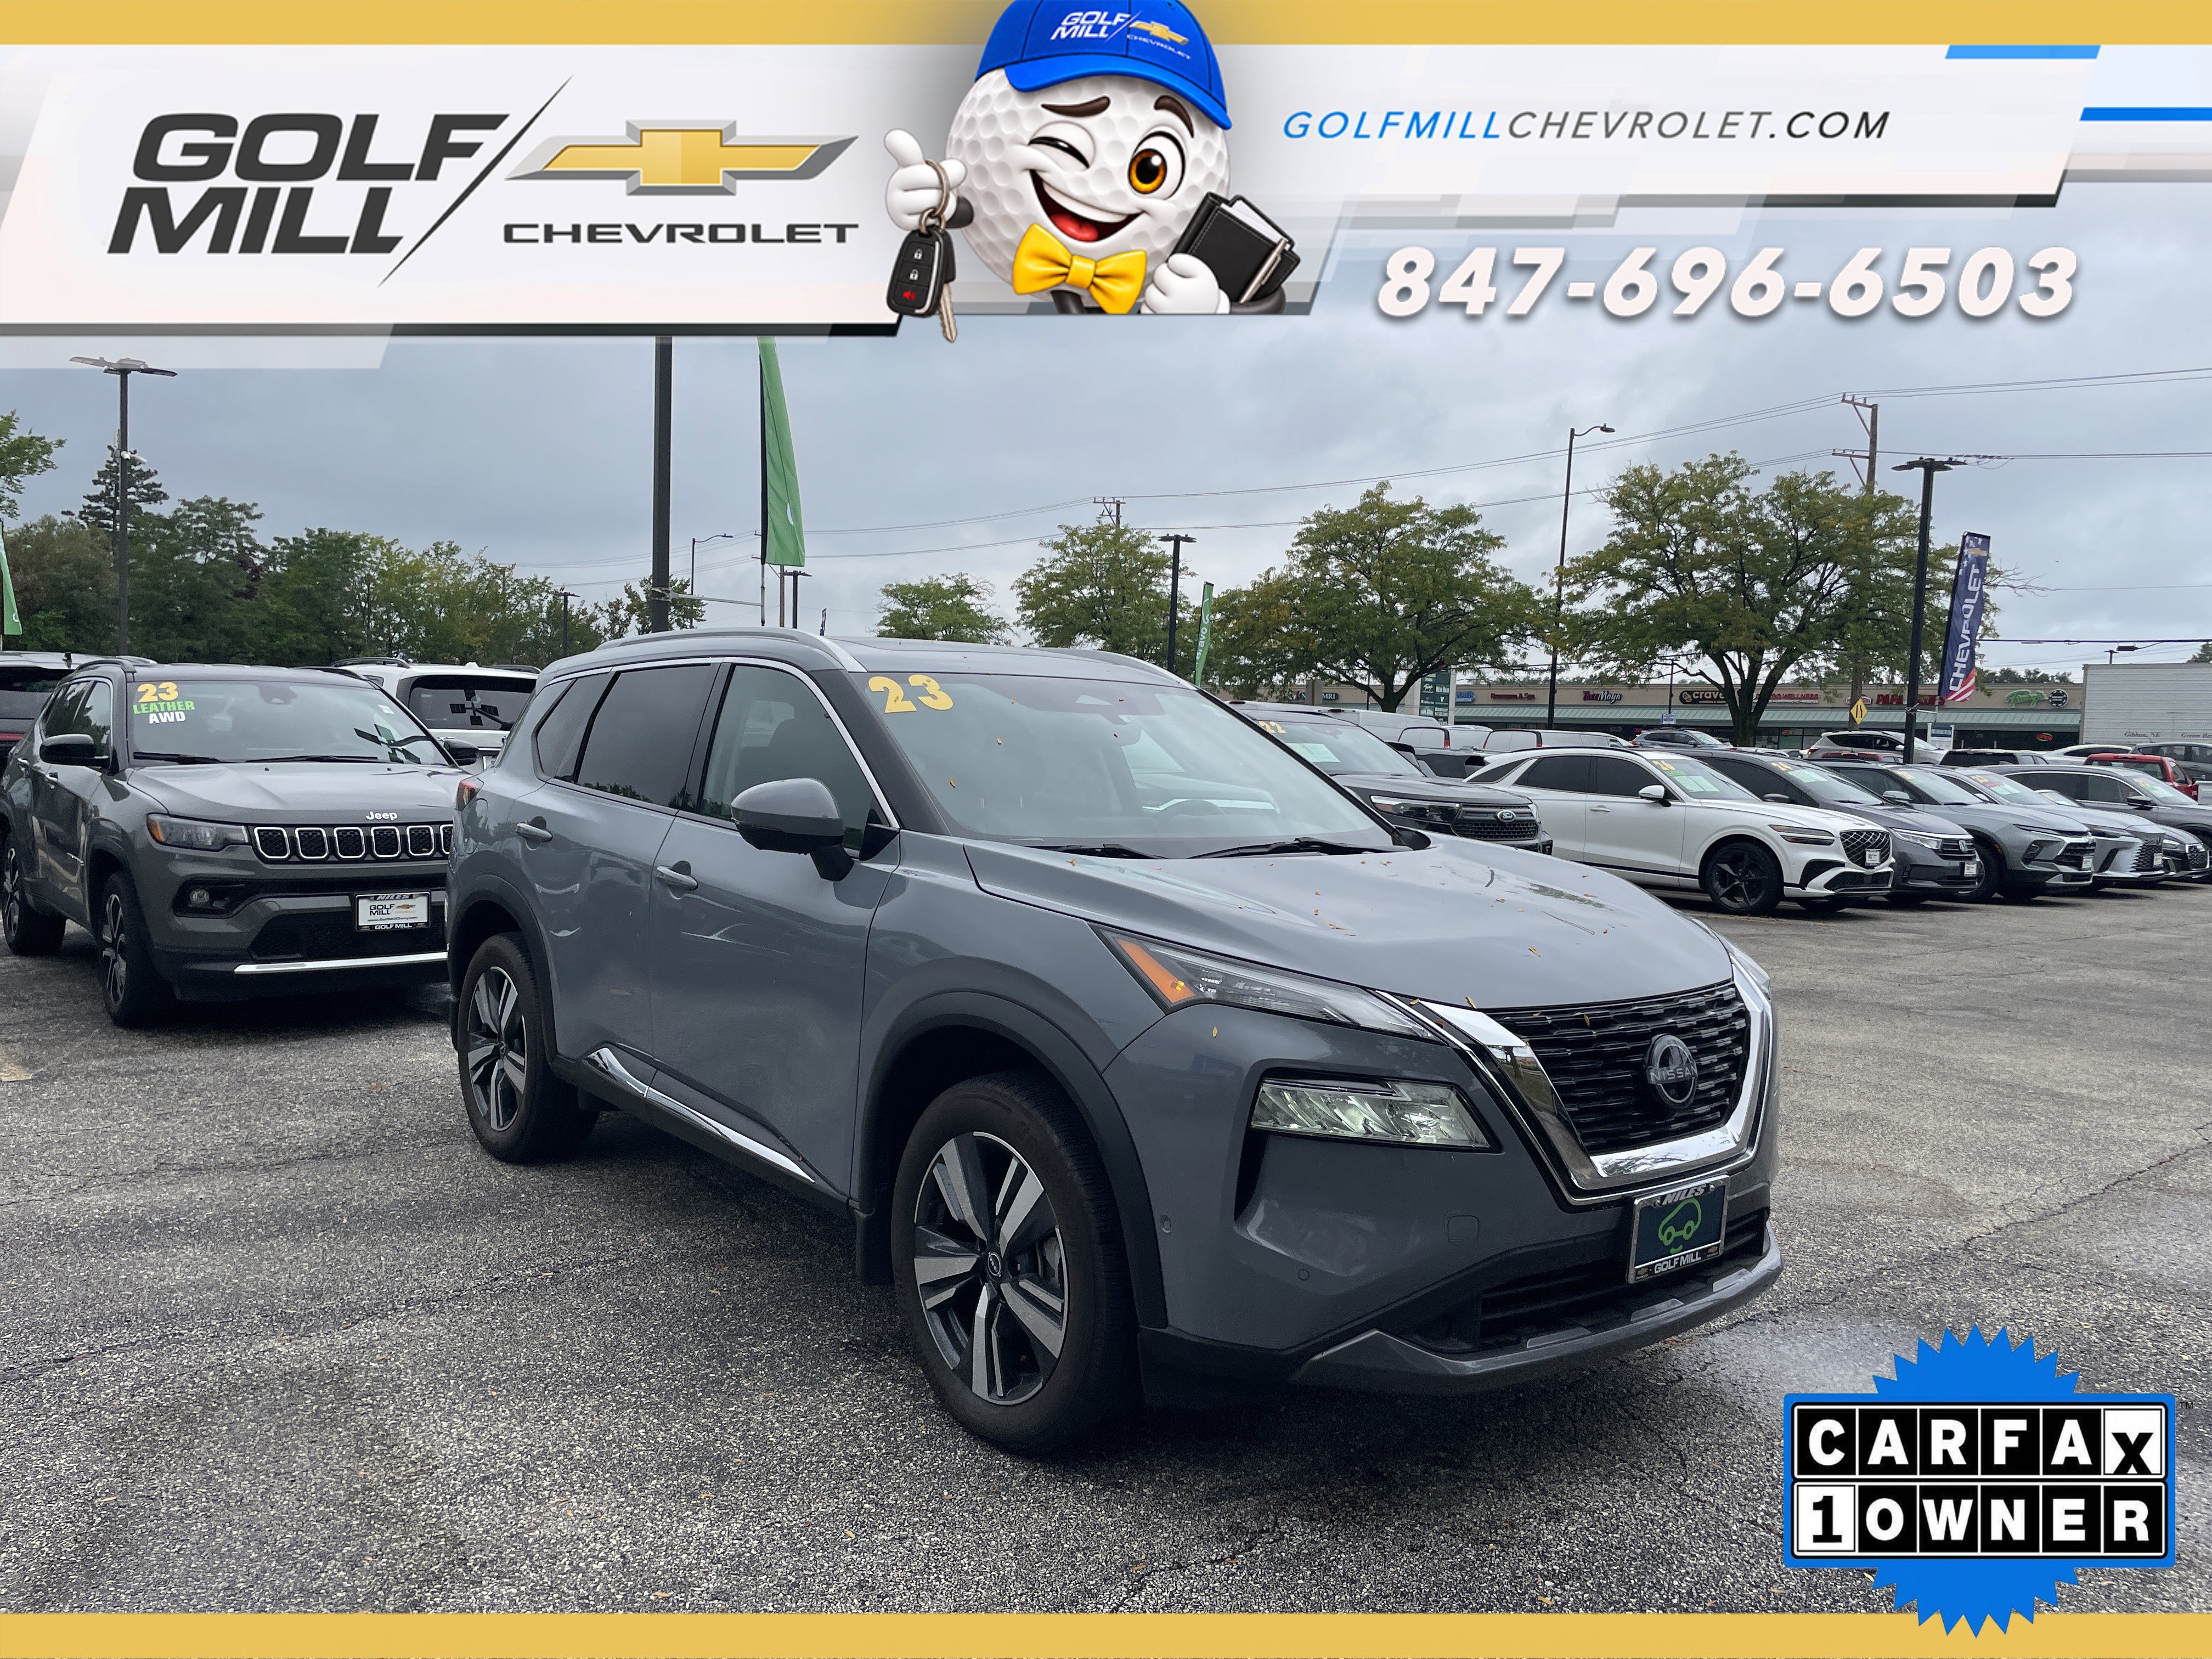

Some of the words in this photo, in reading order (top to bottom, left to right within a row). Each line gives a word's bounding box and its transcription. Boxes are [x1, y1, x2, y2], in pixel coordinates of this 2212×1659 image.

[1949, 563, 1982, 691] CHEVROLET
[137, 681, 179, 703] 23
[868, 674, 954, 714] 23
[133, 701, 195, 714] LEATHER
[149, 711, 186, 724] AWD
[1259, 715, 1287, 733] 22
[365, 811, 398, 821] Jeep
[1650, 1065, 1698, 1082] NISSAN
[1662, 1183, 1707, 1206] NILES
[1654, 1257, 1679, 1274] GOLF
[1680, 1251, 1701, 1267] MILL
